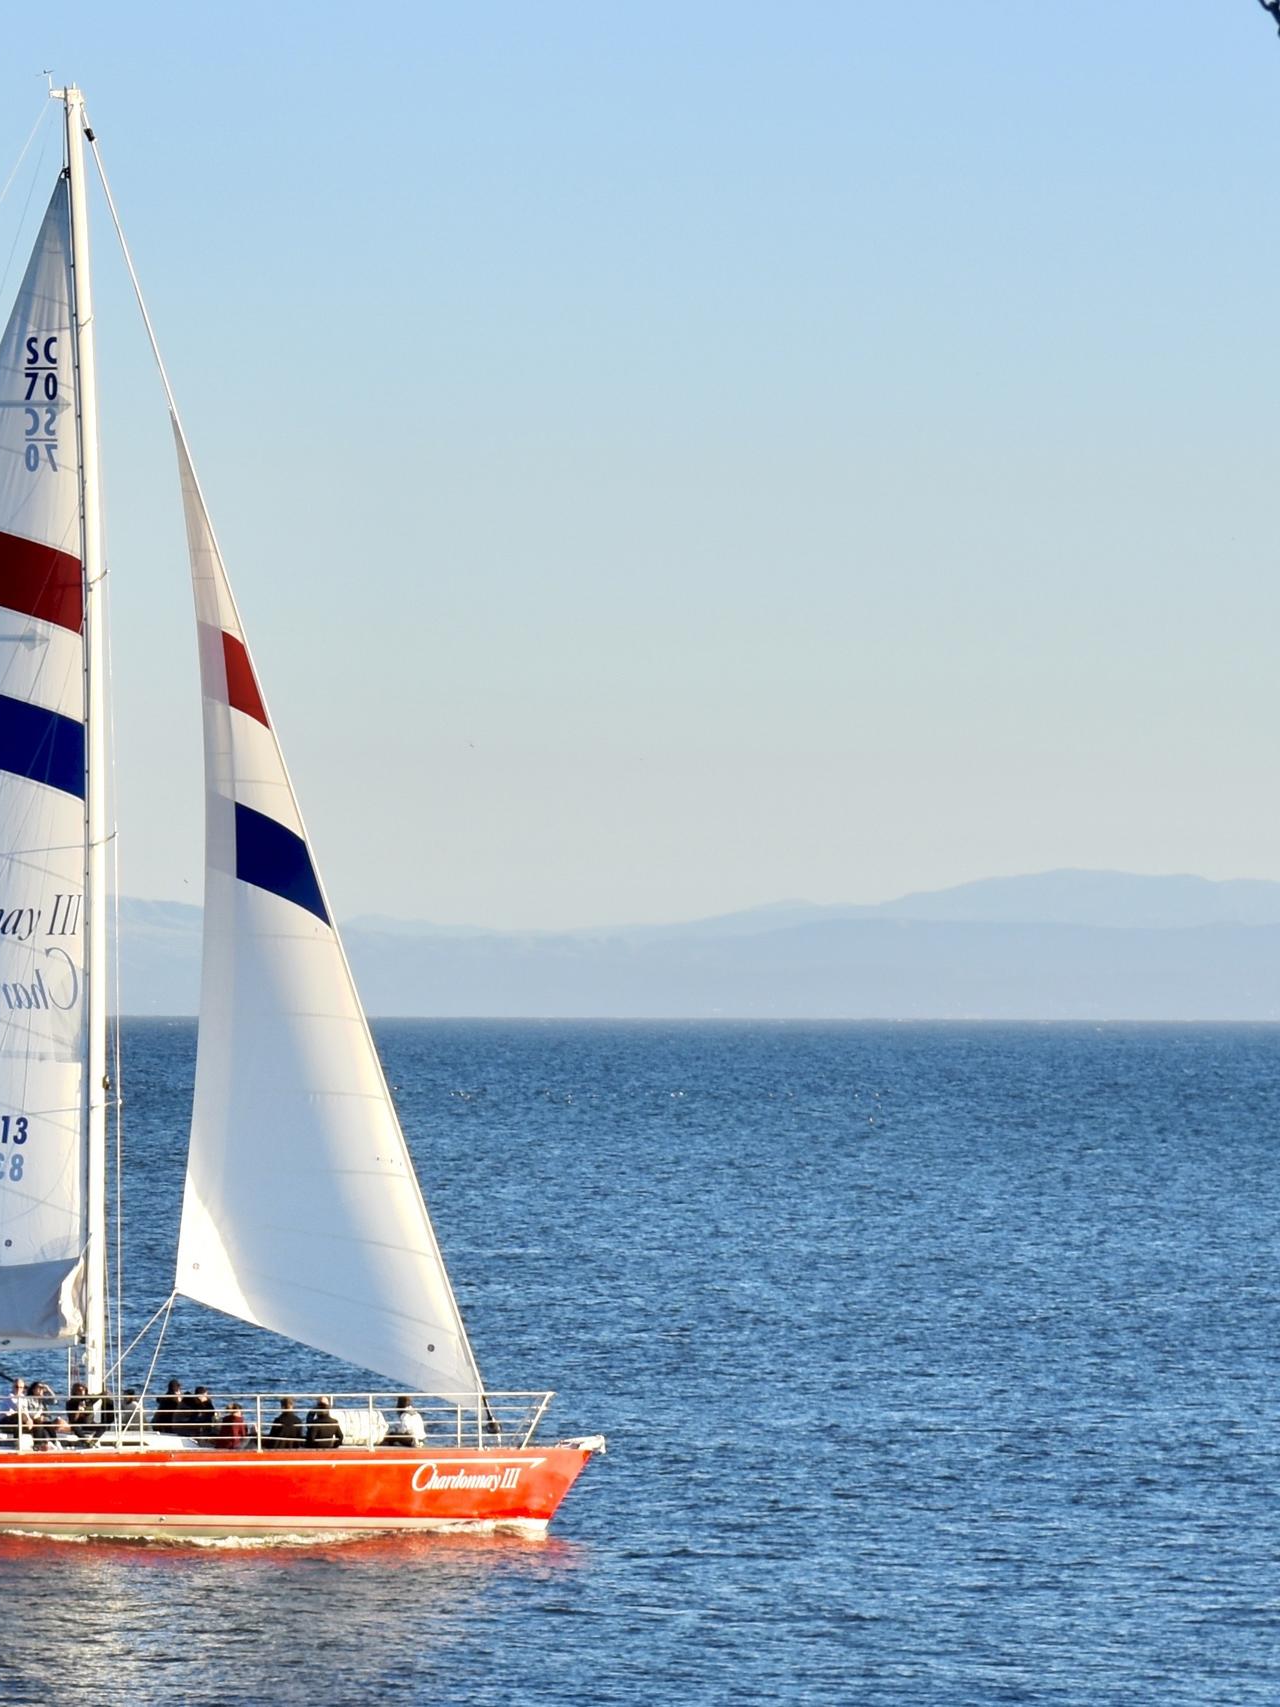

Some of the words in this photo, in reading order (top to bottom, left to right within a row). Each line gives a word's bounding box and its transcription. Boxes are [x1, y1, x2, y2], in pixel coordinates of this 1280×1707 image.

[26, 336, 58, 364] SC
[24, 372, 58, 400] 70
[45, 894, 83, 936] III
[412, 1463, 499, 1492] Chardonnay
[501, 1468, 521, 1489] III
